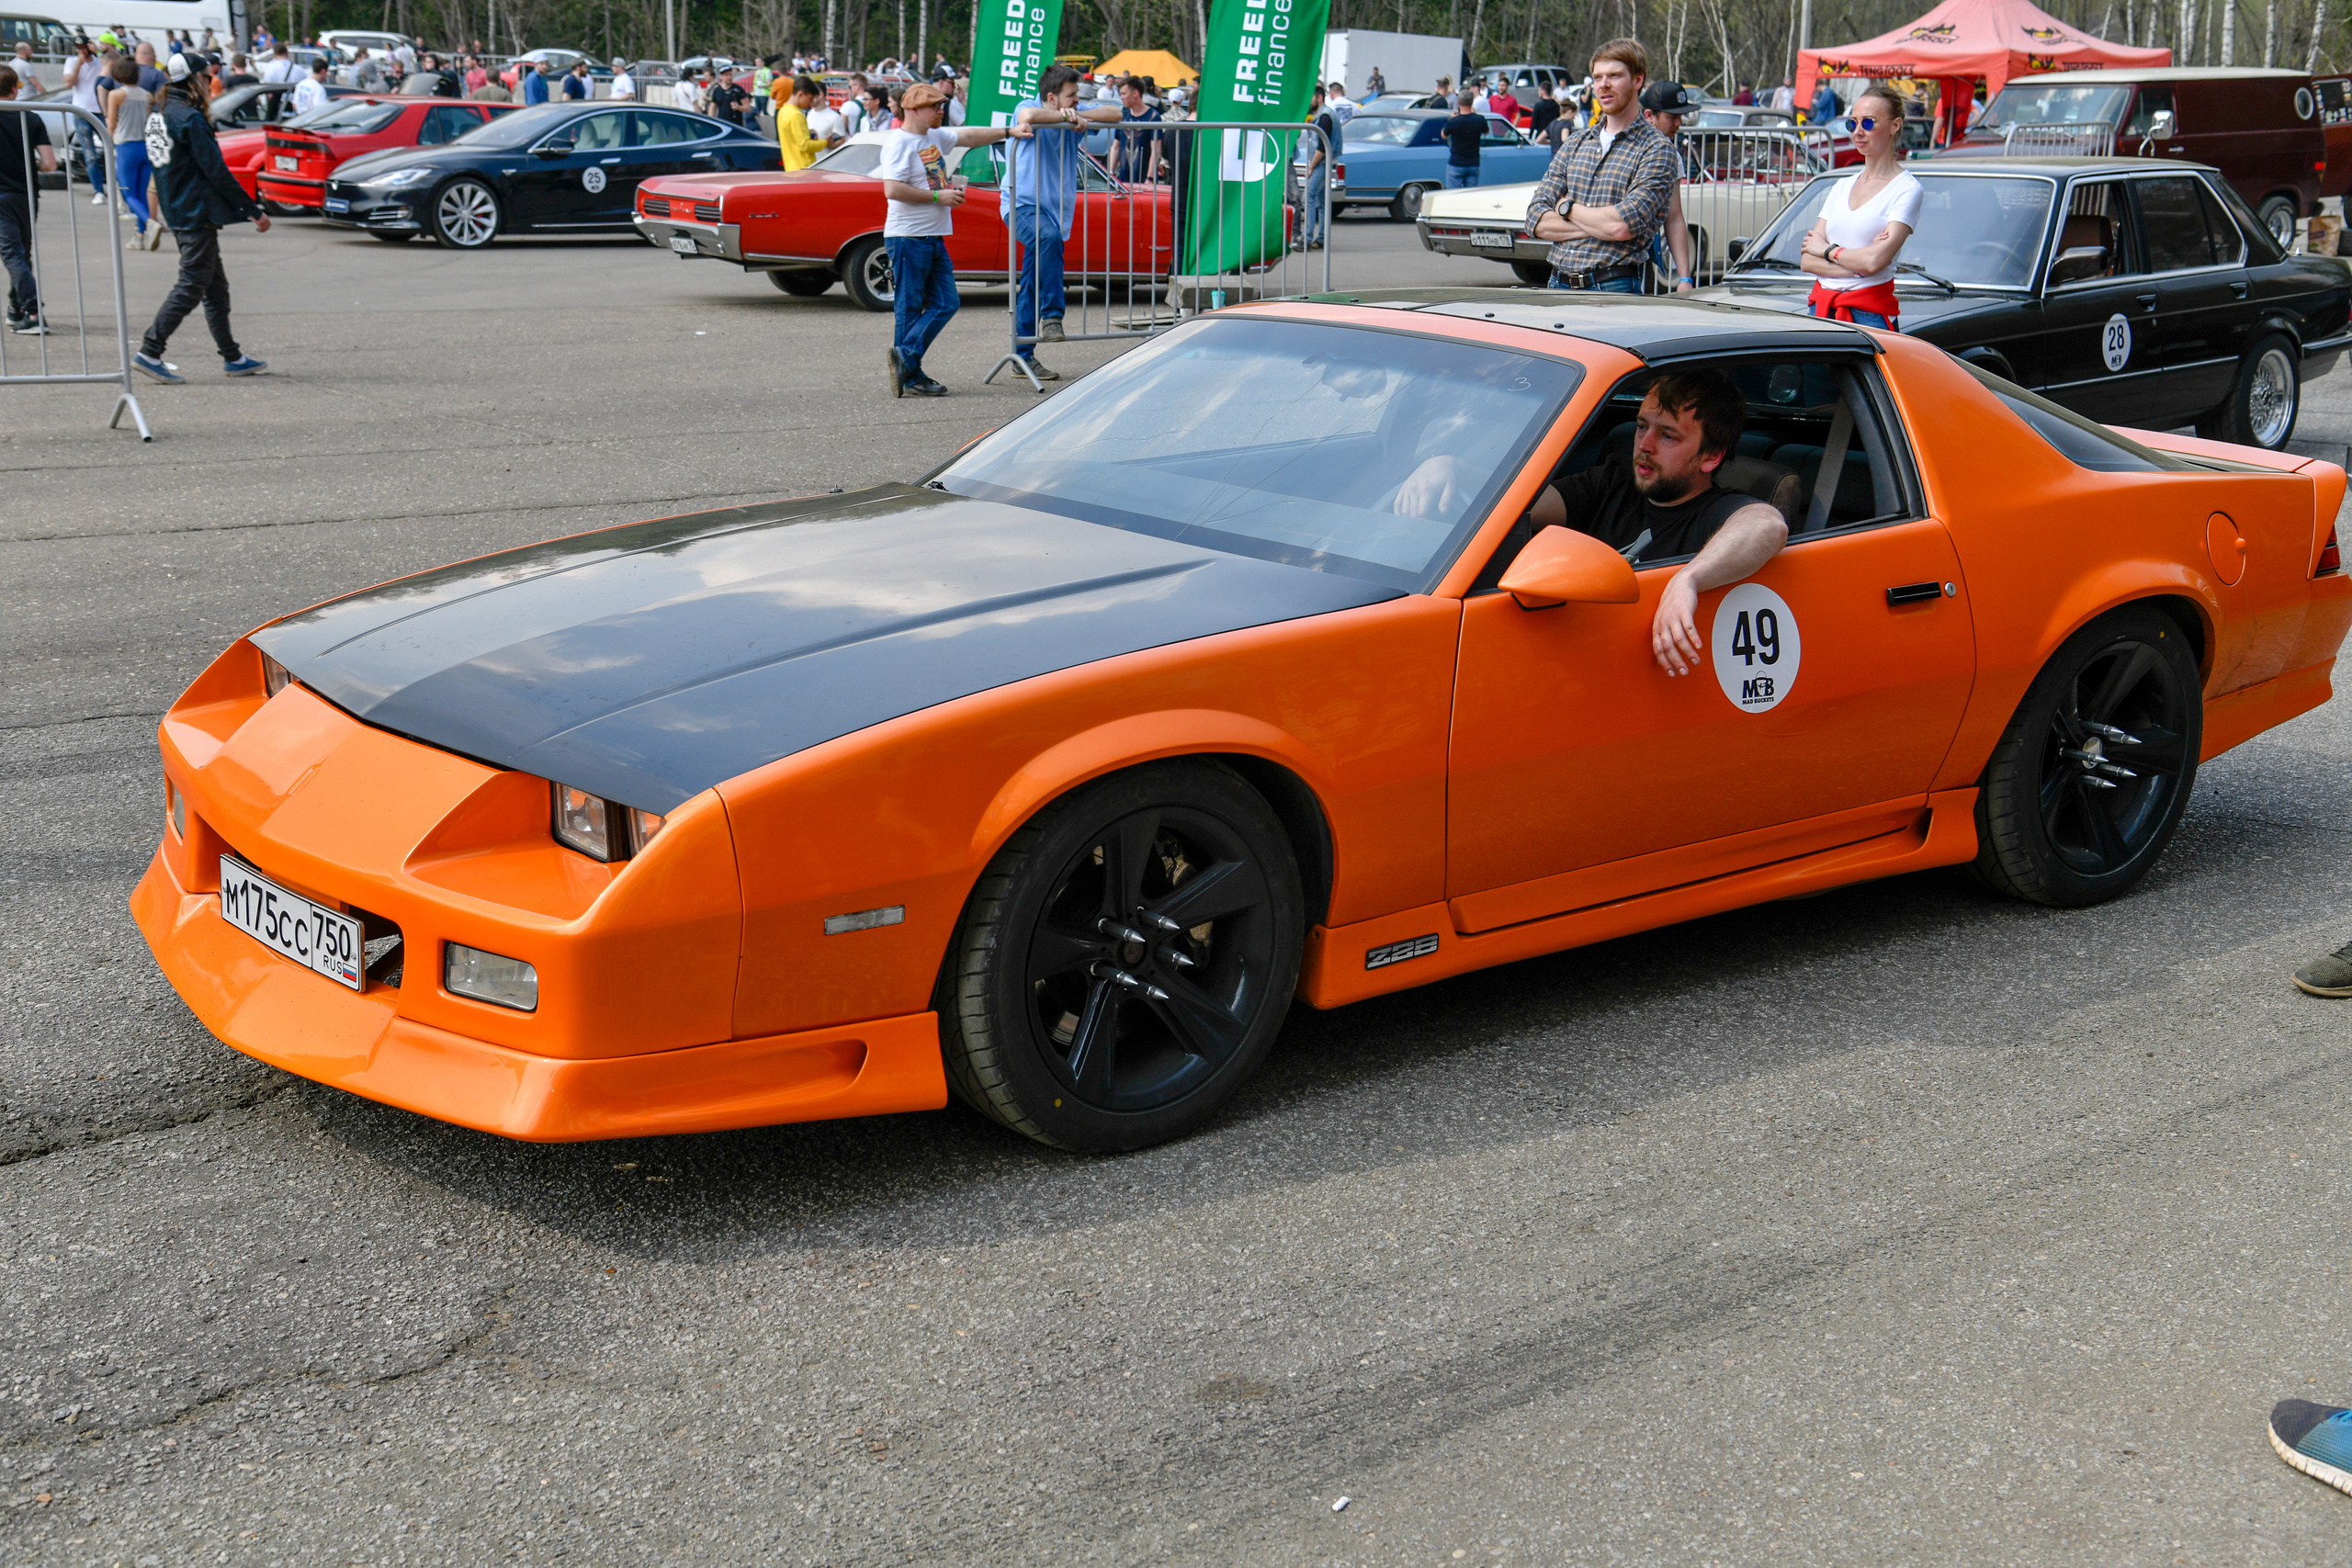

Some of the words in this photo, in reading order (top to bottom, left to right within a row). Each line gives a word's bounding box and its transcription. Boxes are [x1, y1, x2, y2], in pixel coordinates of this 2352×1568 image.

[1019, 7, 1045, 98] finance
[1258, 0, 1292, 105] finance
[588, 172, 601, 184] 25
[2109, 324, 2124, 351] 28
[1732, 608, 1781, 666] 49
[312, 910, 351, 962] 750
[1366, 933, 1439, 969] Z28
[323, 954, 343, 975] RUS
